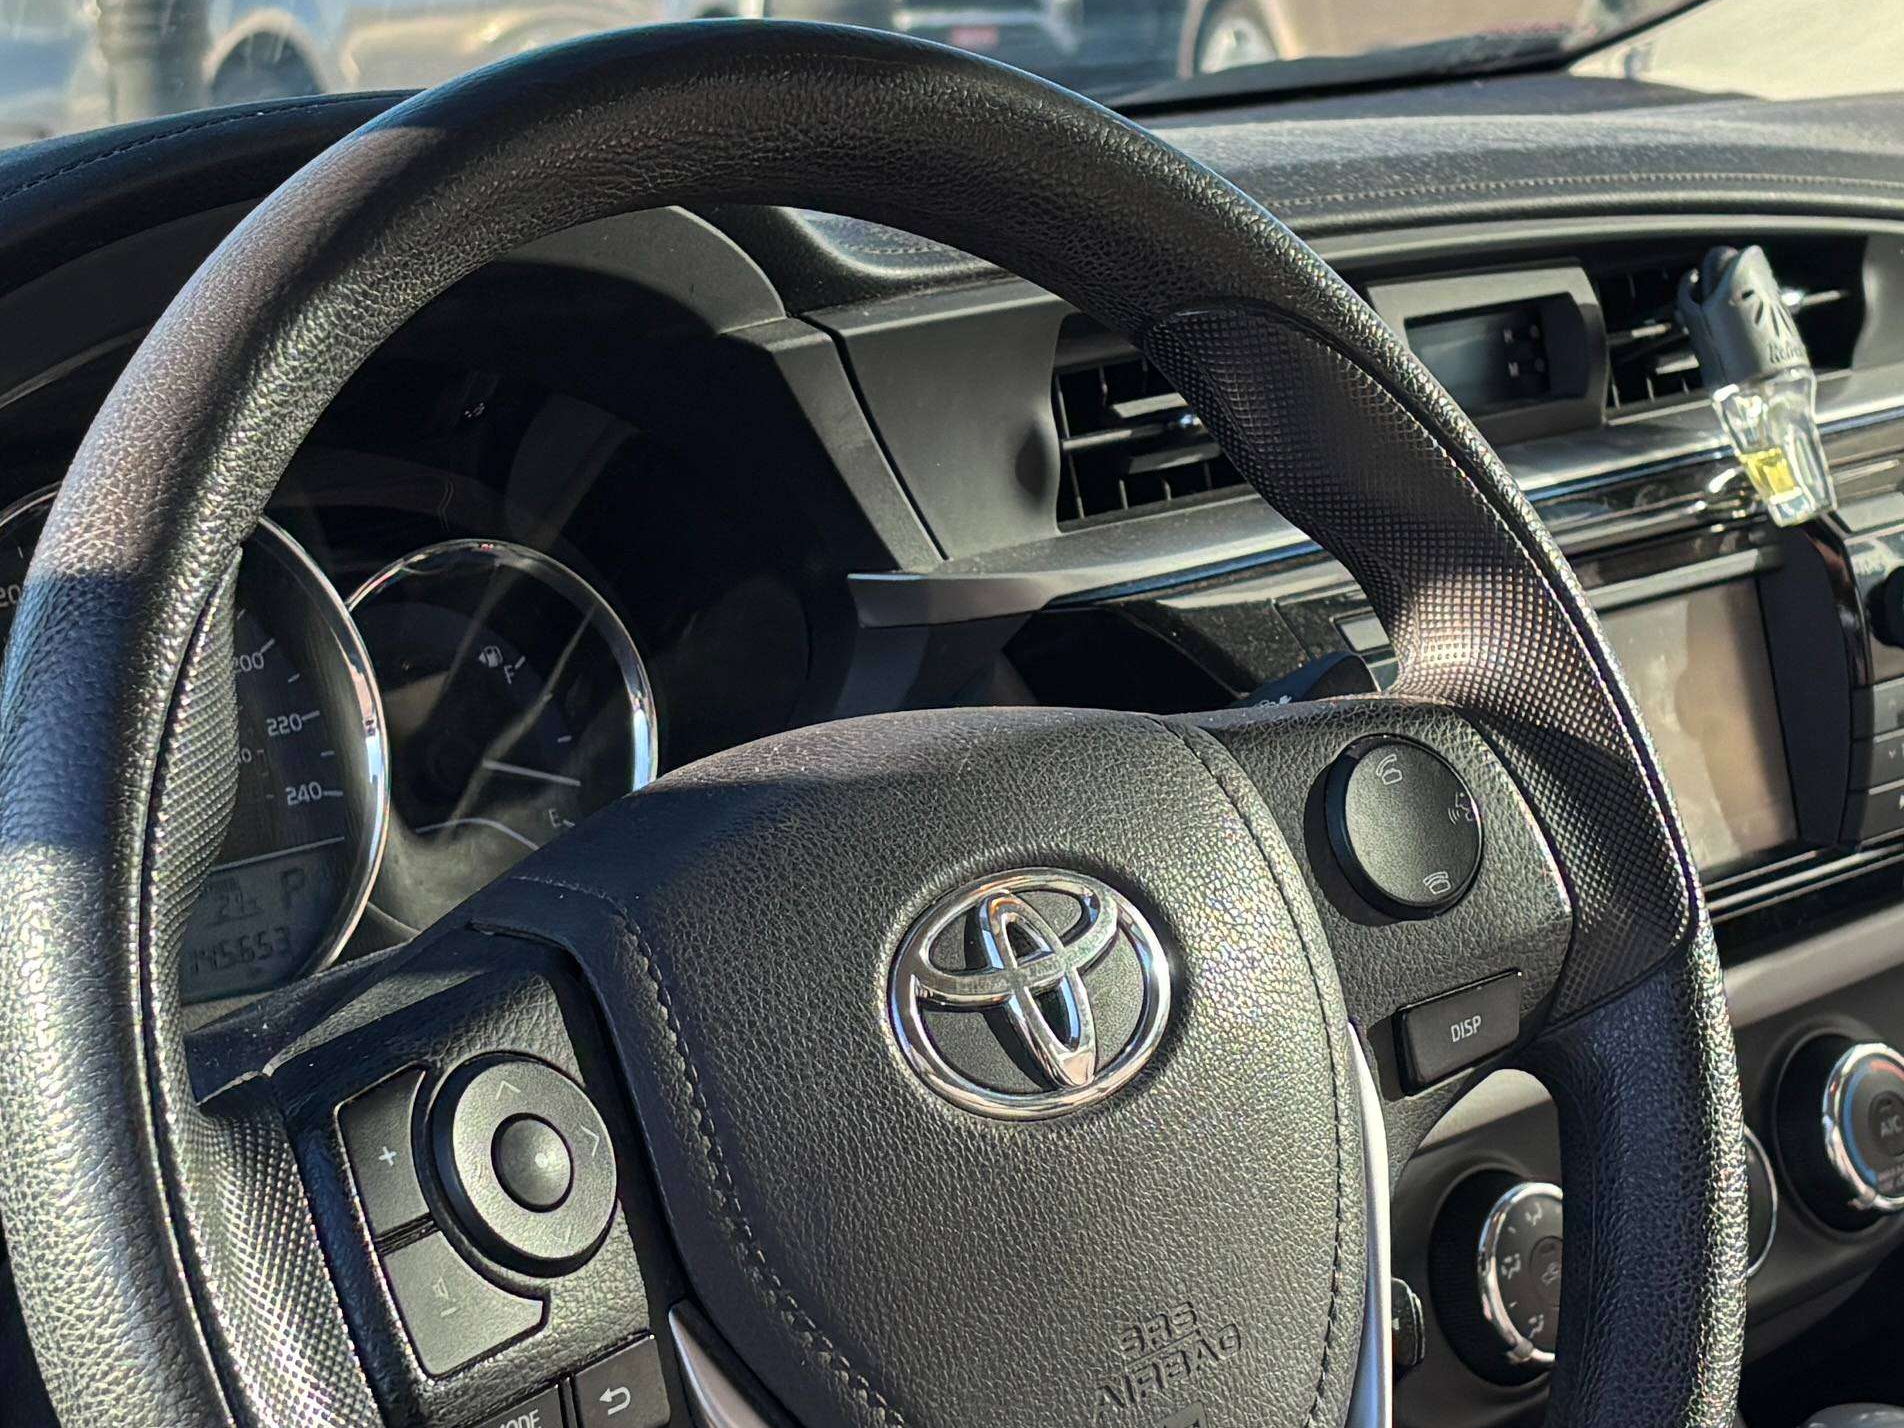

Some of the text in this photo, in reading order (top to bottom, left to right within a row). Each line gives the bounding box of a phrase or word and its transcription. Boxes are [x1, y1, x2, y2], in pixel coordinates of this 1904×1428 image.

[504, 665, 514, 684] F
[267, 714, 302, 737] 220
[286, 781, 322, 806] 240
[549, 808, 561, 828] E
[1450, 1015, 1482, 1043] DISP
[1118, 1301, 1197, 1354] SRS
[1096, 1323, 1242, 1417] AIRBAG
